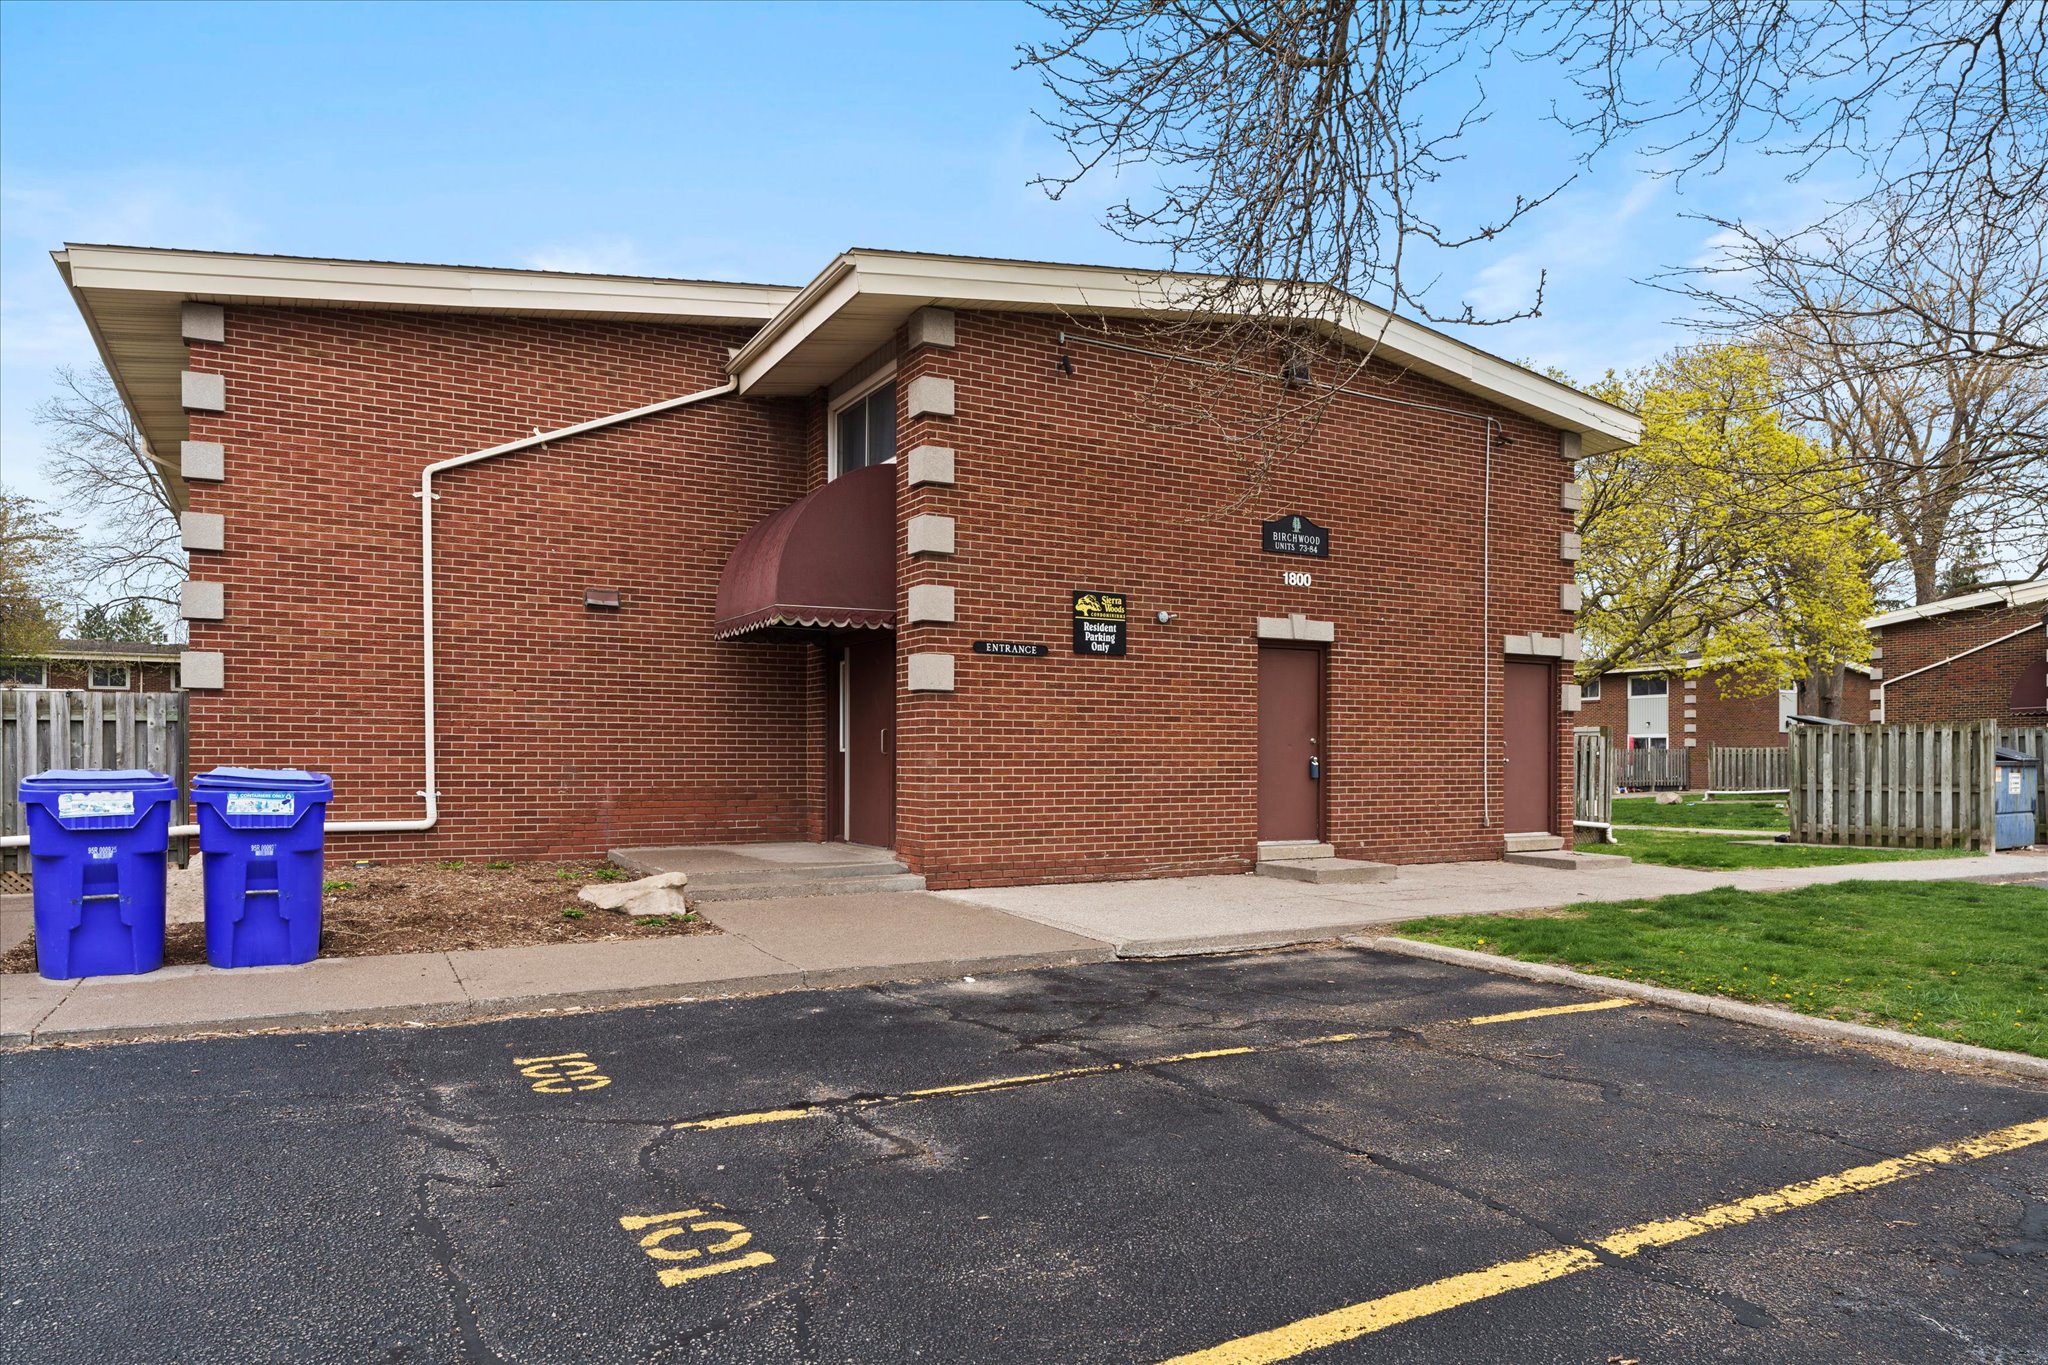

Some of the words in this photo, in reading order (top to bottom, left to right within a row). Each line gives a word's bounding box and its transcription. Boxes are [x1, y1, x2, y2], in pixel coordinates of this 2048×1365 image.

[1273, 531, 1320, 545] BIRCHWOOD
[1275, 542, 1295, 551] UNITS
[1299, 544, 1318, 553] 73-84
[1283, 572, 1311, 586] 1800
[1101, 596, 1122, 605] Sierra
[1104, 604, 1125, 613] Woods
[1083, 622, 1117, 633] Resident
[1085, 632, 1116, 644] Parking
[986, 643, 1037, 655] ENTRANCE
[1091, 642, 1110, 653] Only
[512, 1052, 612, 1093] 100
[619, 1203, 777, 1288] 101
